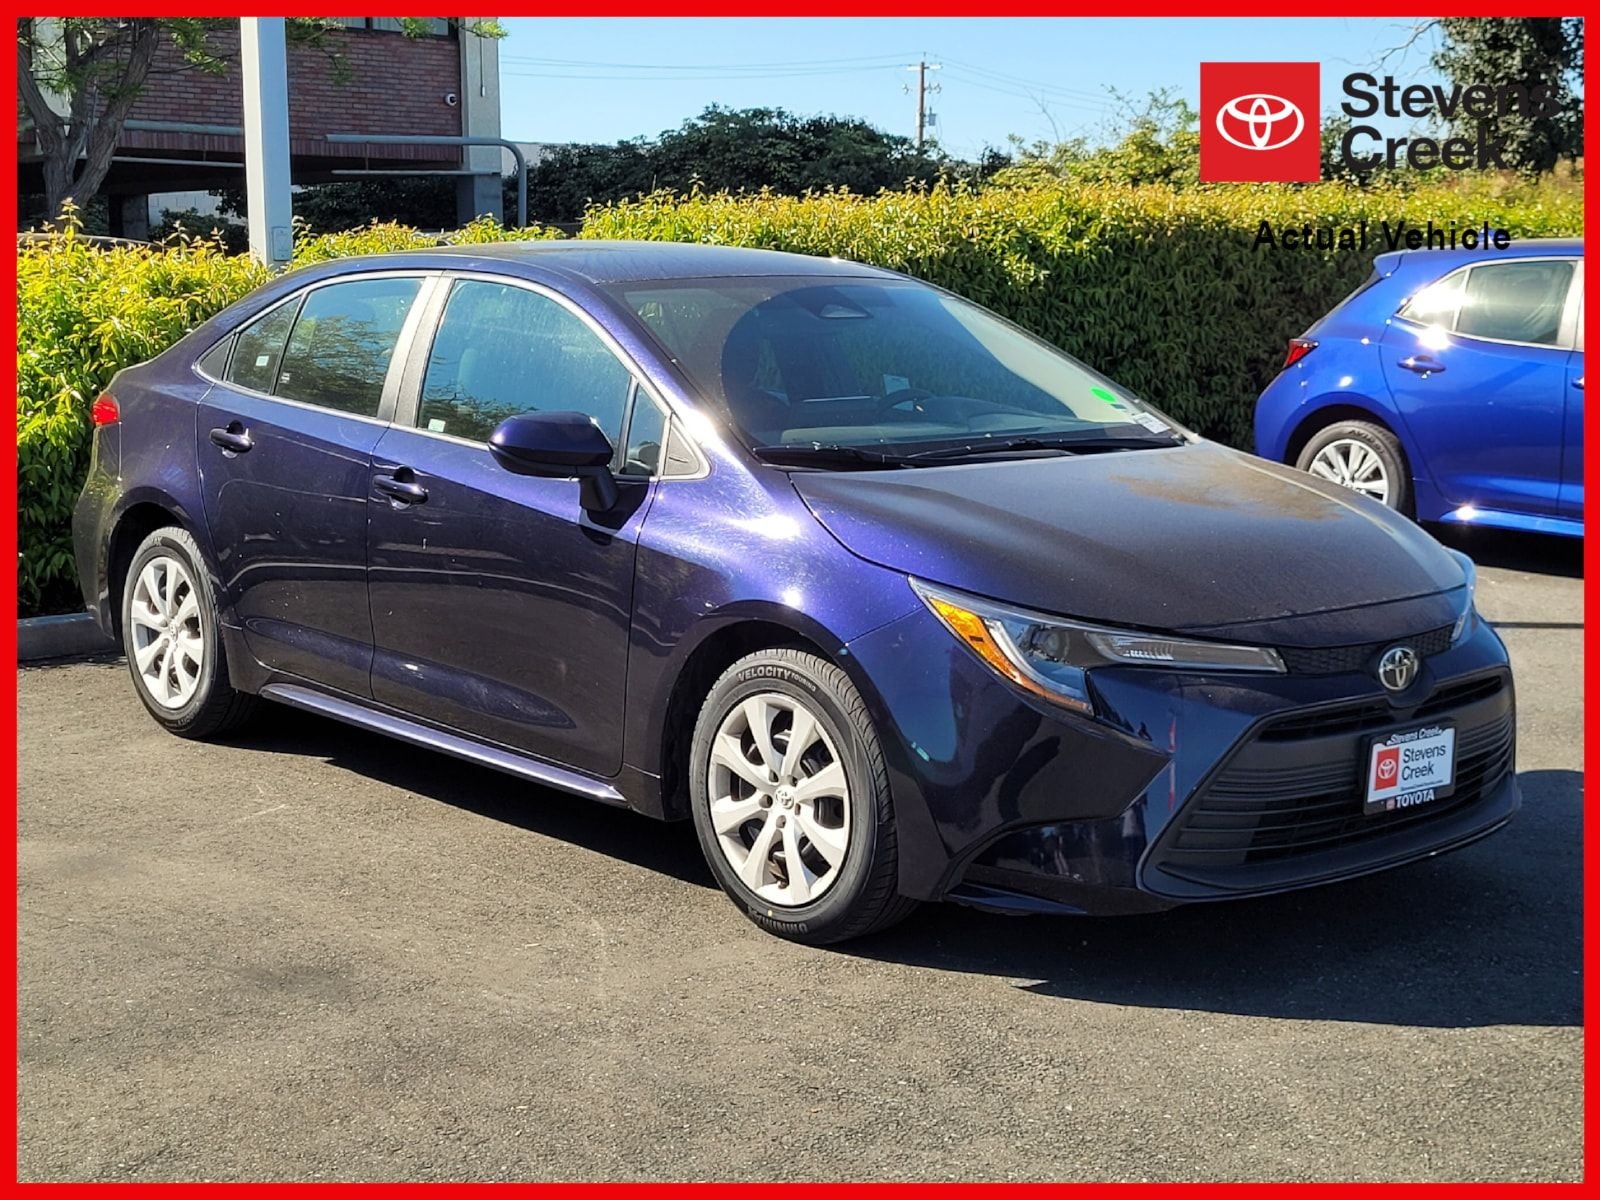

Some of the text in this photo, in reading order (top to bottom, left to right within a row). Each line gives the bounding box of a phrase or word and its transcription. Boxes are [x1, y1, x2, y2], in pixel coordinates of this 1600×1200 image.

[737, 666, 817, 692] VELOCITY TOURING
[1402, 744, 1446, 763] Stevens
[1401, 760, 1434, 781] Creek
[1395, 789, 1435, 808] TOYOTA
